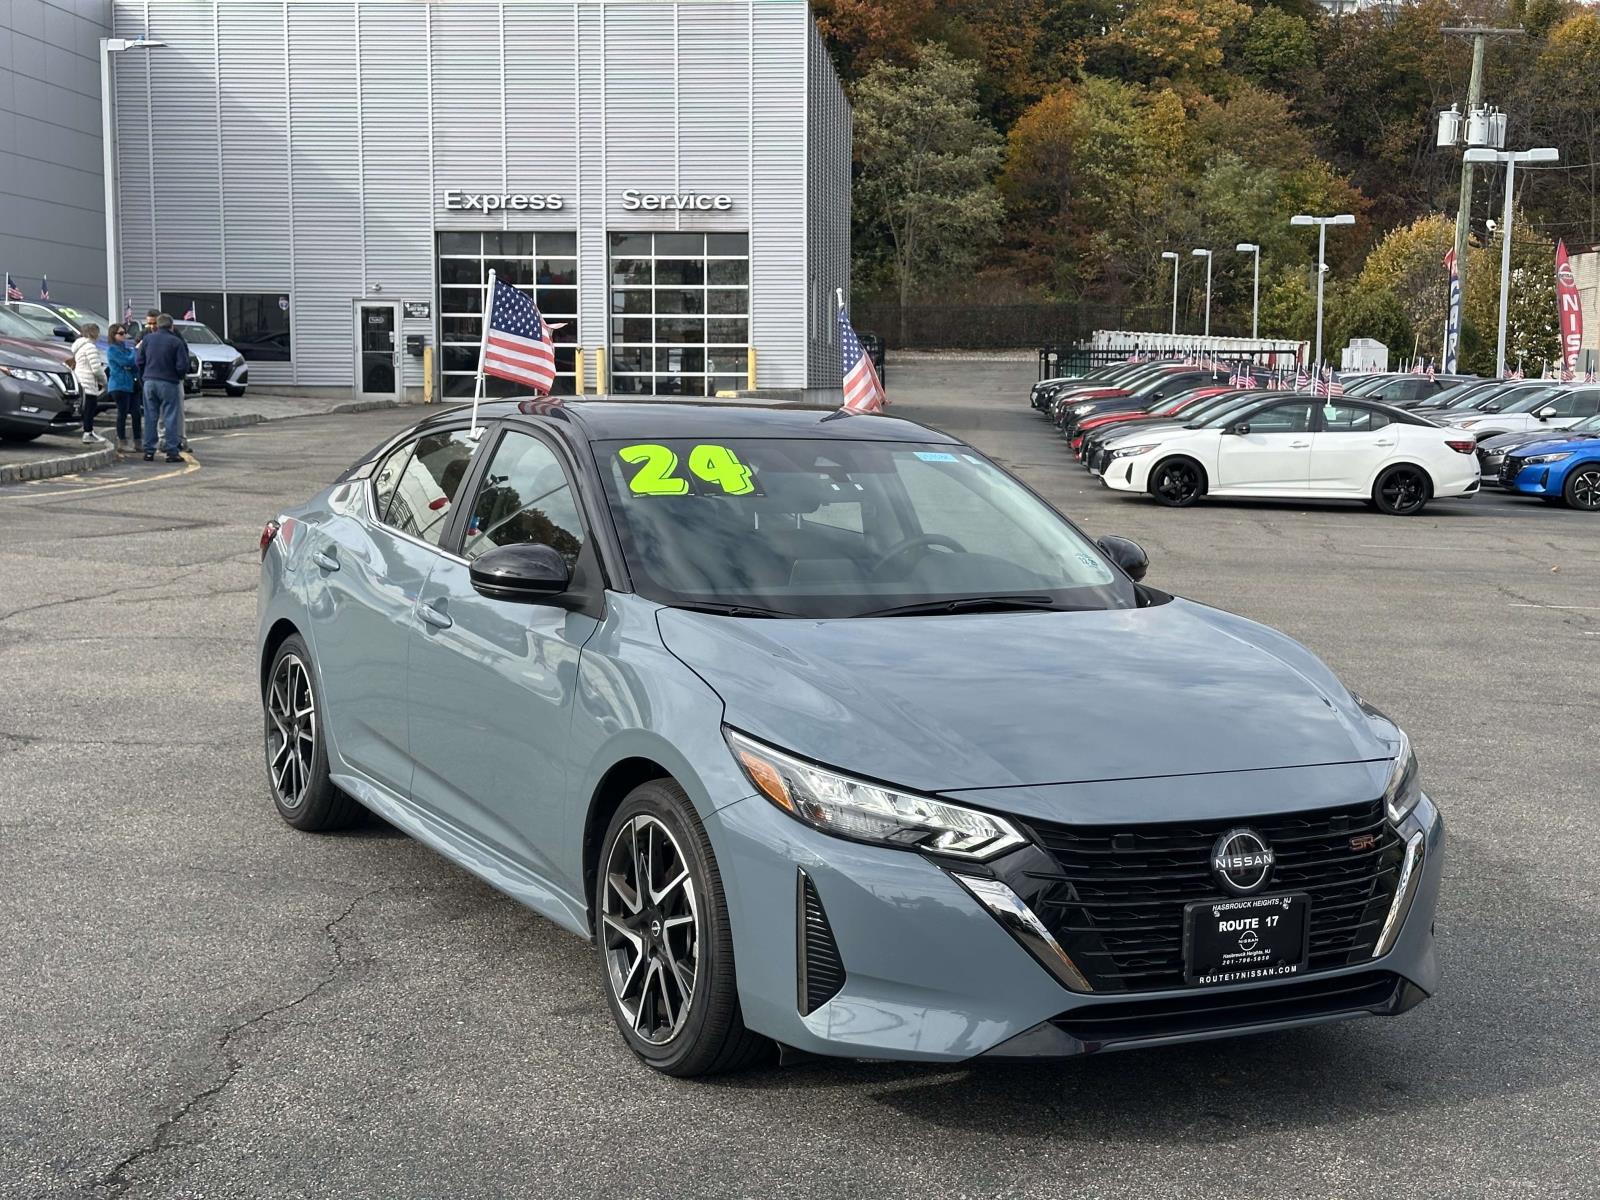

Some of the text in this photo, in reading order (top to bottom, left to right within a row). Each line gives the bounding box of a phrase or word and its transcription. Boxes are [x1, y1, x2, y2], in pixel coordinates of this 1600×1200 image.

[443, 188, 733, 214] Express Service
[618, 444, 755, 495] 24
[1350, 835, 1375, 850] SR
[1215, 853, 1272, 869] NISSAN
[1212, 901, 1252, 912] HASBROUCK
[1283, 896, 1292, 904] NJ
[1219, 915, 1279, 932] ROUTE 17
[1222, 951, 1246, 959] Hasbrouck
[1199, 965, 1297, 983] ROUTE17NISSAN.COM
